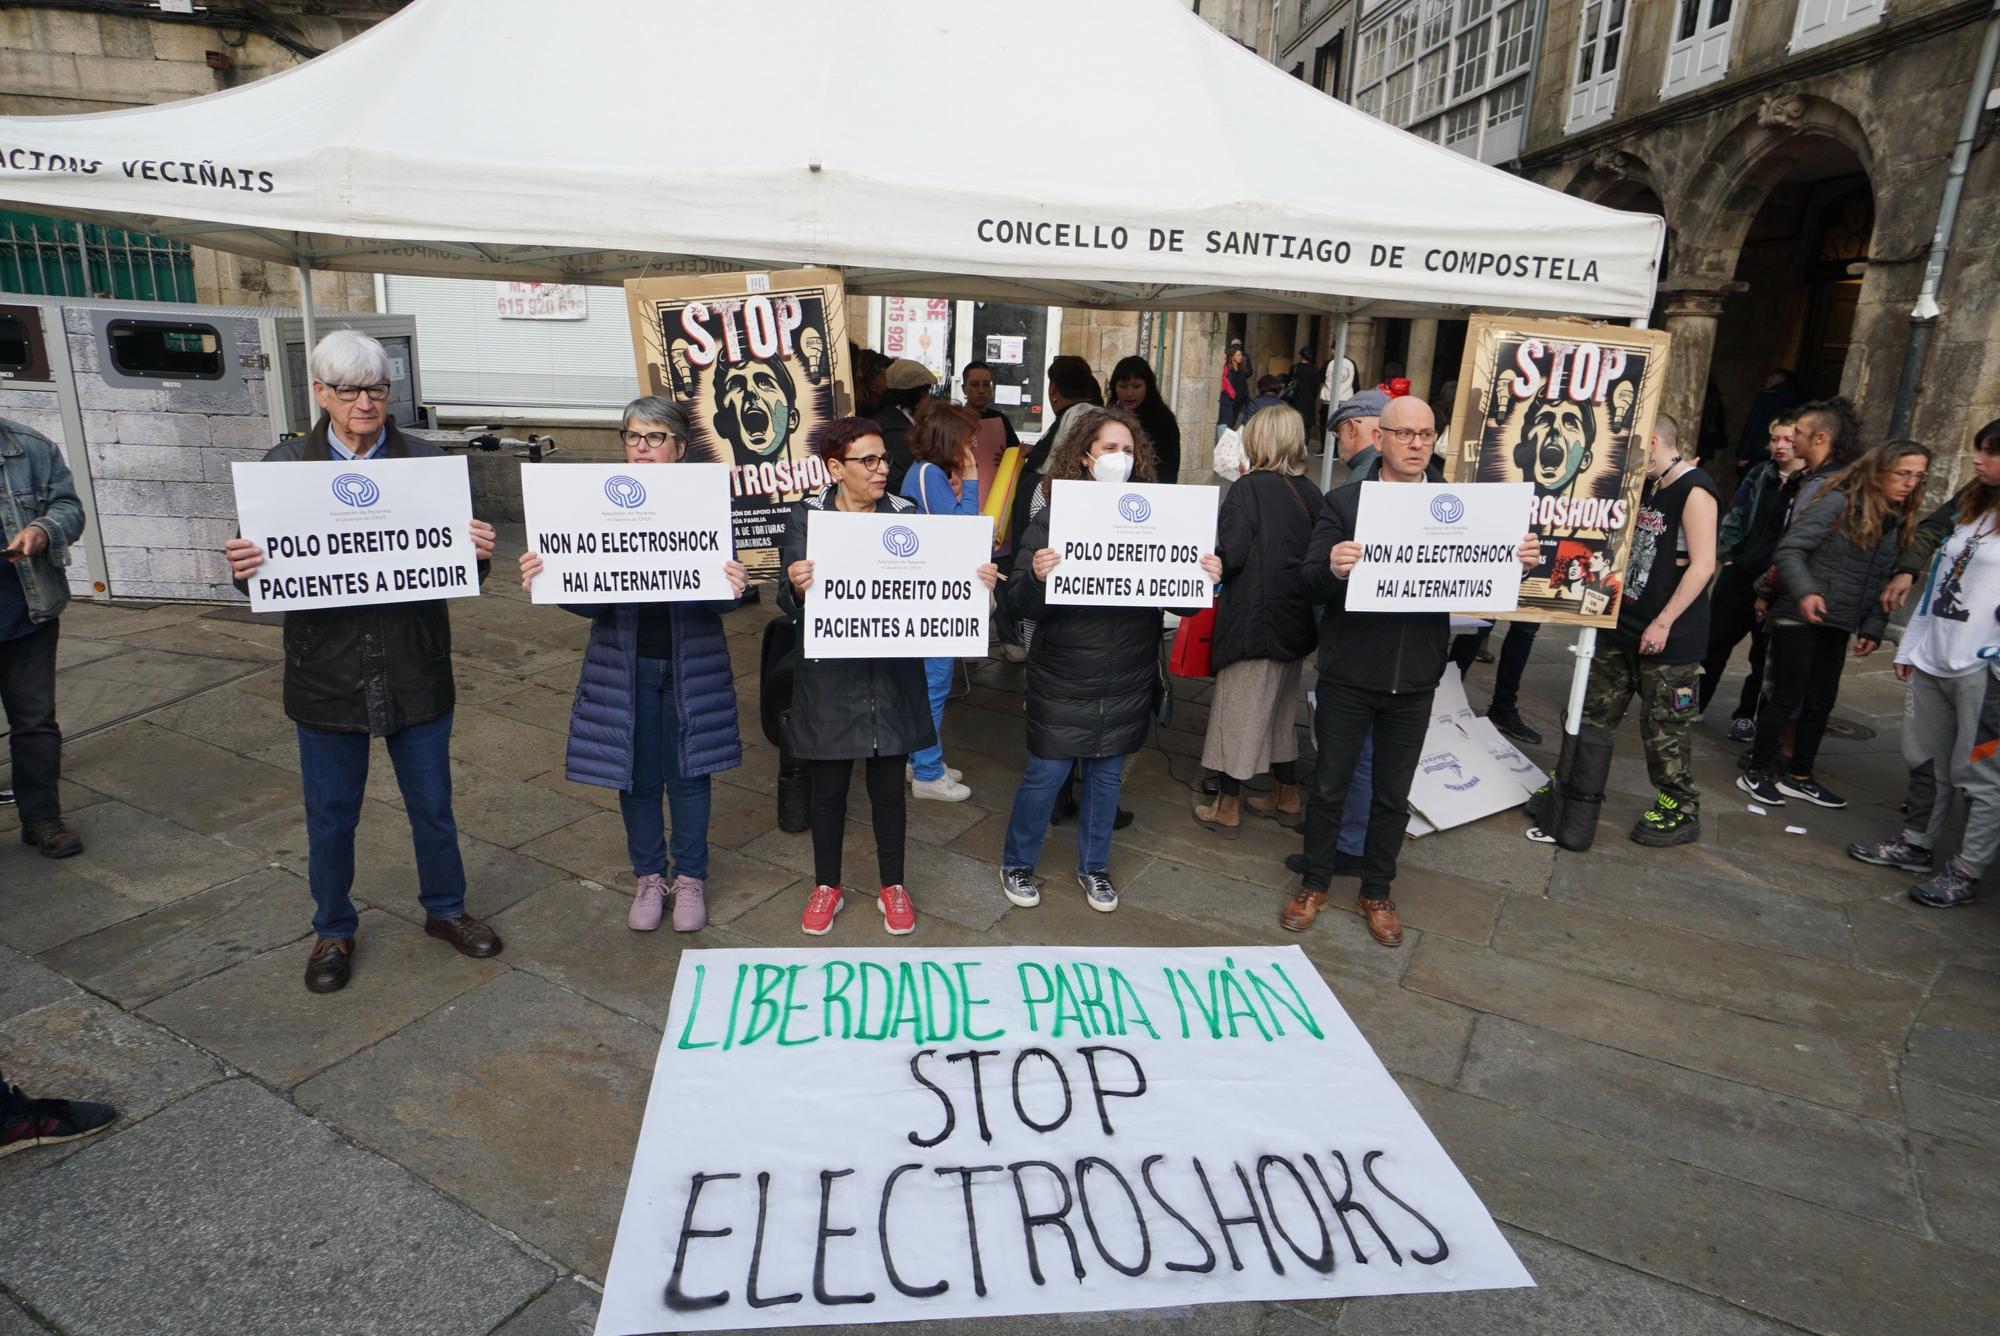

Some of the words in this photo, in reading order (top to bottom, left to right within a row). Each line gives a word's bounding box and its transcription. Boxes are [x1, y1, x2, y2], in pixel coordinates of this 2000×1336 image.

[122, 160, 274, 194] VECIÑAIS
[976, 218, 1129, 251] CONCELLO
[1148, 226, 1184, 252] DE
[1205, 230, 1352, 264] SANTIAGO
[1370, 245, 1405, 269] DE
[1423, 248, 1599, 283] COMPOSTELA
[681, 295, 802, 367] STOP
[888, 326, 904, 352] 920
[1509, 338, 1627, 405] STOP
[267, 535, 320, 559] POLO
[327, 530, 409, 555] DEREITO
[416, 527, 452, 549] DOS
[539, 533, 571, 554] NON
[577, 533, 596, 554] AO
[601, 531, 719, 553] ELECTROSHOCK
[1065, 542, 1102, 561] POLO
[1107, 543, 1166, 562] DEREITO
[1171, 545, 1198, 563] DOS
[1363, 544, 1392, 563] NON
[1395, 544, 1413, 563] AO
[1417, 544, 1516, 563] ELECTROSHOCK
[260, 572, 369, 600] PACIENTES
[376, 571, 388, 592] A
[393, 565, 467, 590] DECIDIR
[563, 572, 588, 592] HAI
[593, 569, 700, 592] ALTERNATIVAS
[825, 579, 866, 600] POLO
[871, 580, 936, 600] DEREITO
[942, 581, 972, 600] DOS
[1054, 576, 1131, 596] PACIENTES
[1136, 578, 1144, 596] A
[1150, 579, 1204, 597] DECIDIR
[1376, 579, 1399, 598] HAI
[1401, 579, 1493, 598] ALTERNATIVAS
[815, 617, 900, 638] PACIENTES
[905, 618, 915, 637] A
[920, 618, 979, 637] DECIDIR
[677, 961, 1006, 1051] LIBERDADE
[1018, 961, 1161, 1039] PARA
[1166, 955, 1325, 1042] IVÁN
[909, 1046, 1148, 1147] STOP
[661, 1149, 1451, 1311] ELECTROSHOKS
